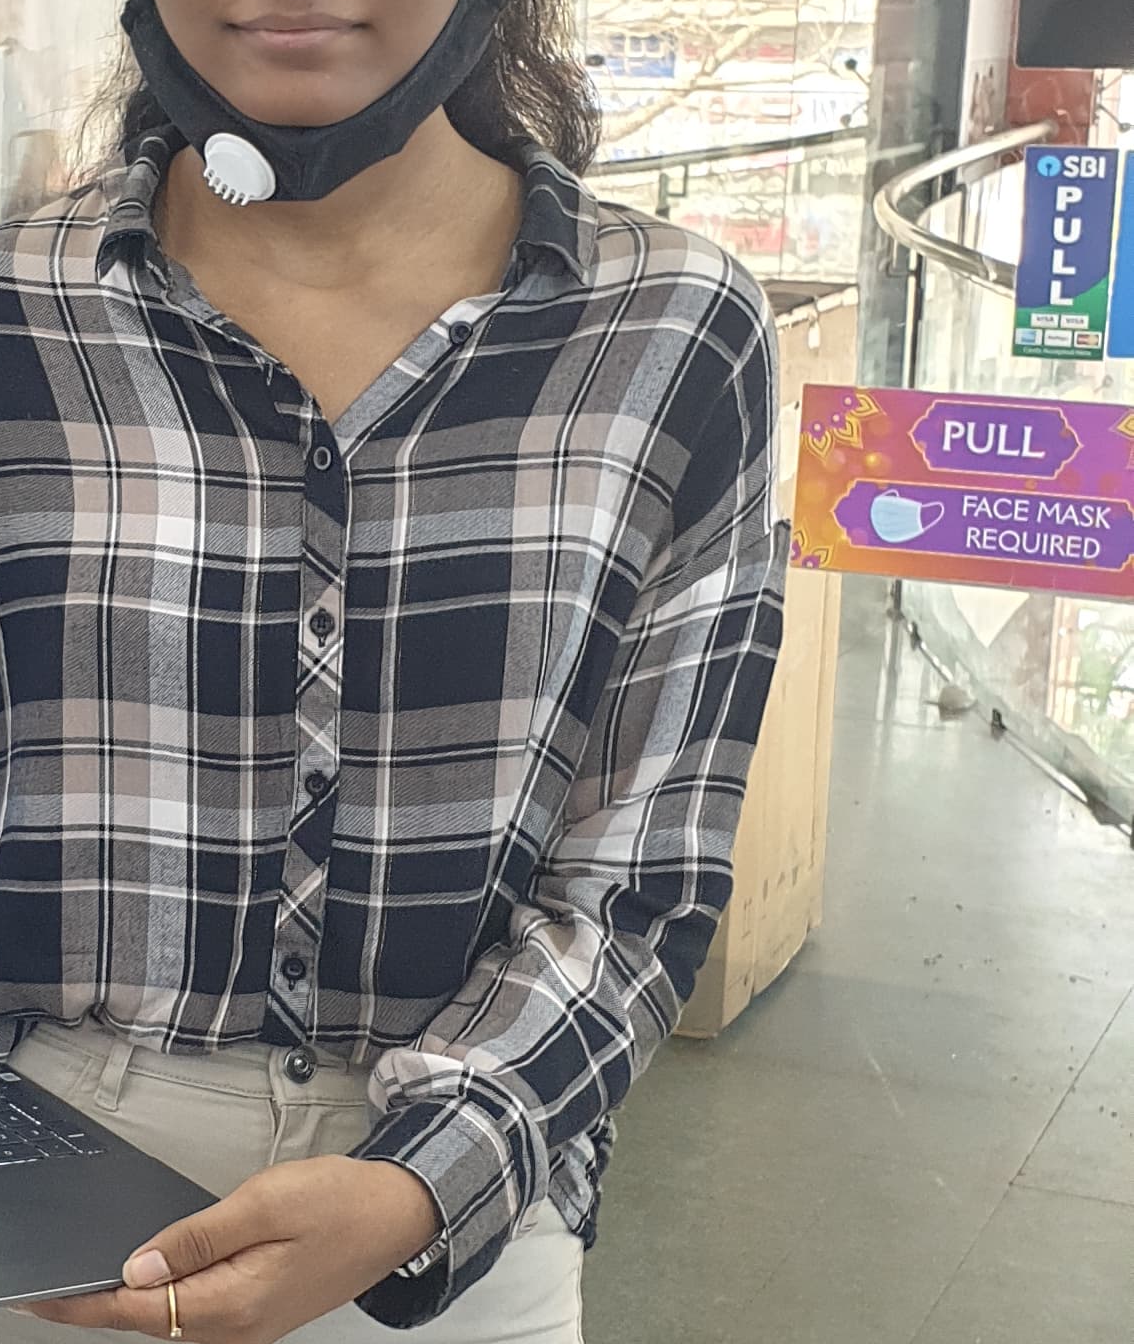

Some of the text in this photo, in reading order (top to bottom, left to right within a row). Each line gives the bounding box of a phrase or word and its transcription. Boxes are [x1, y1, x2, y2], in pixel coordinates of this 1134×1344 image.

[1062, 154, 1107, 179] SBI
[1050, 185, 1083, 307] PULL
[942, 419, 1046, 459] PULL
[961, 494, 1112, 530] FACE MASK
[965, 526, 1102, 560] REQUIRED
